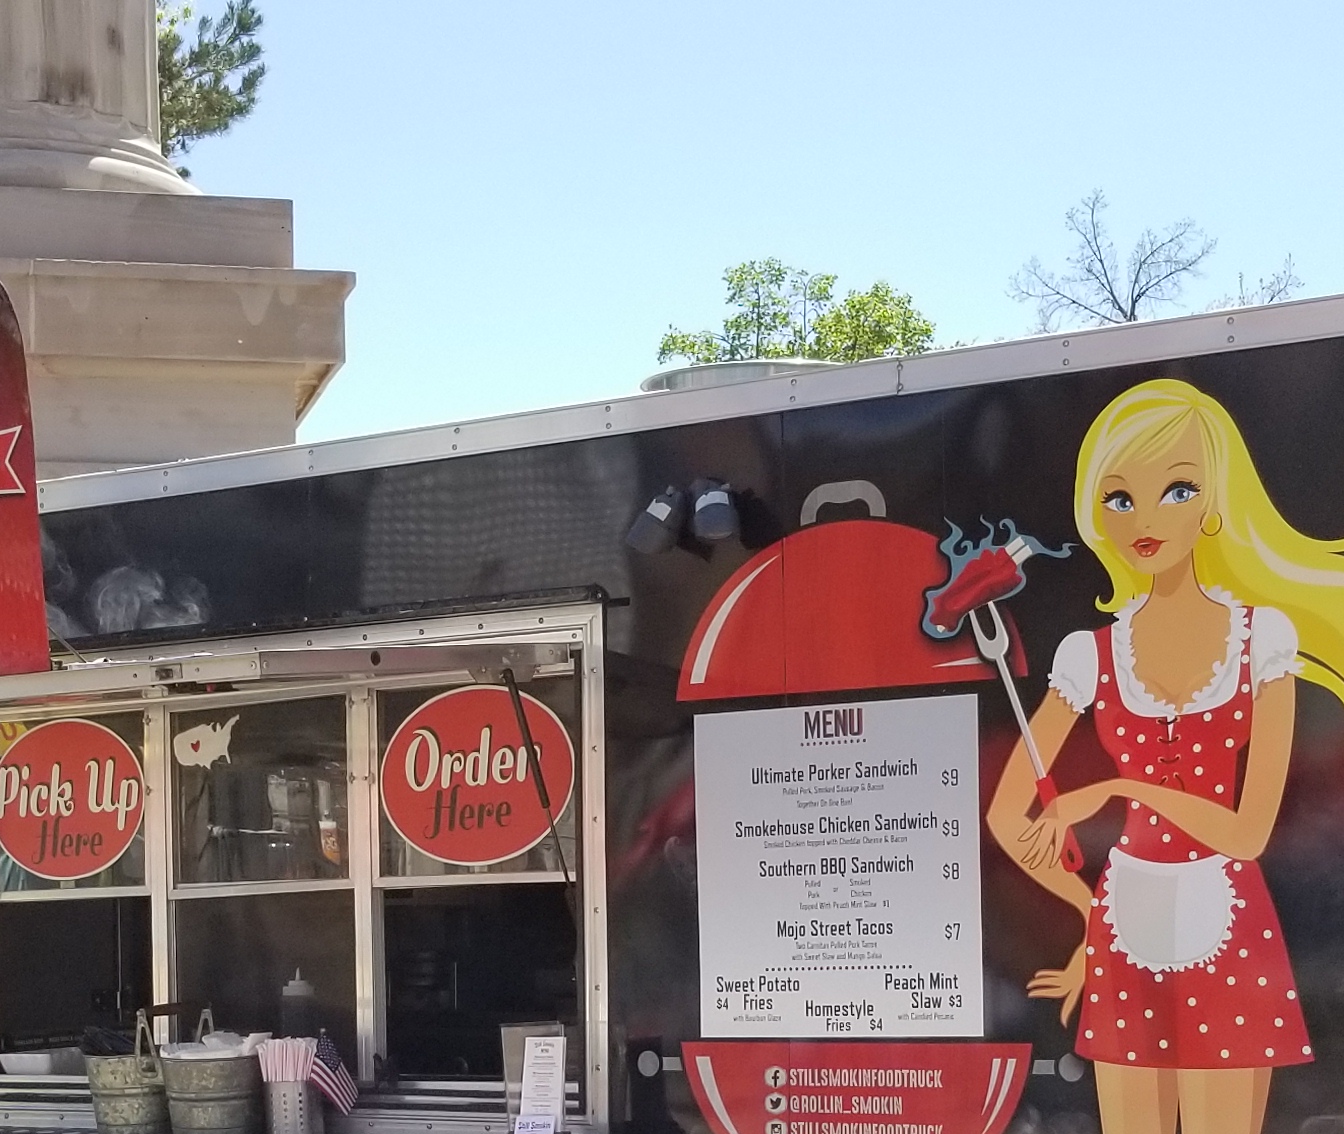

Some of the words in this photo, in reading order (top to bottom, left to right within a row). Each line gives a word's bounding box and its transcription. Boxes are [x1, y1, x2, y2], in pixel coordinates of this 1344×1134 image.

[804, 708, 863, 740] MENU
[405, 727, 542, 792] Order
[751, 767, 804, 785] Ultimate
[809, 763, 851, 782] Porker
[855, 758, 918, 779] Sandwich
[941, 768, 959, 786] $9
[85, 759, 139, 831] Up
[424, 784, 512, 839] Here
[735, 820, 815, 838] Smokehouse
[819, 816, 870, 834] Chicken
[874, 811, 938, 832] Sandwich
[942, 820, 959, 837] $9
[32, 816, 103, 864] Here
[759, 860, 816, 877] Southern
[820, 857, 846, 877] BBQ
[851, 854, 914, 874] Sandwich
[942, 863, 960, 880] $8
[777, 921, 806, 940] Mojo
[810, 920, 852, 936] Street
[856, 918, 893, 935] Tacos
[945, 923, 961, 940] $7
[716, 976, 755, 992] Sweet
[759, 975, 800, 992] Potato
[884, 973, 925, 990] Peach
[929, 972, 958, 990] Mint
[716, 997, 729, 1010] $4
[744, 994, 773, 1010] Fries
[805, 999, 874, 1020] Homestyle
[911, 992, 942, 1009] Slaw
[949, 994, 962, 1008] $3
[826, 1018, 851, 1032] Fries
[869, 1018, 883, 1032] $4
[789, 1068, 943, 1088] STILLSMOKINFOODTRUCK
[790, 1095, 903, 1115] @ROLLIN_SMOKIN
